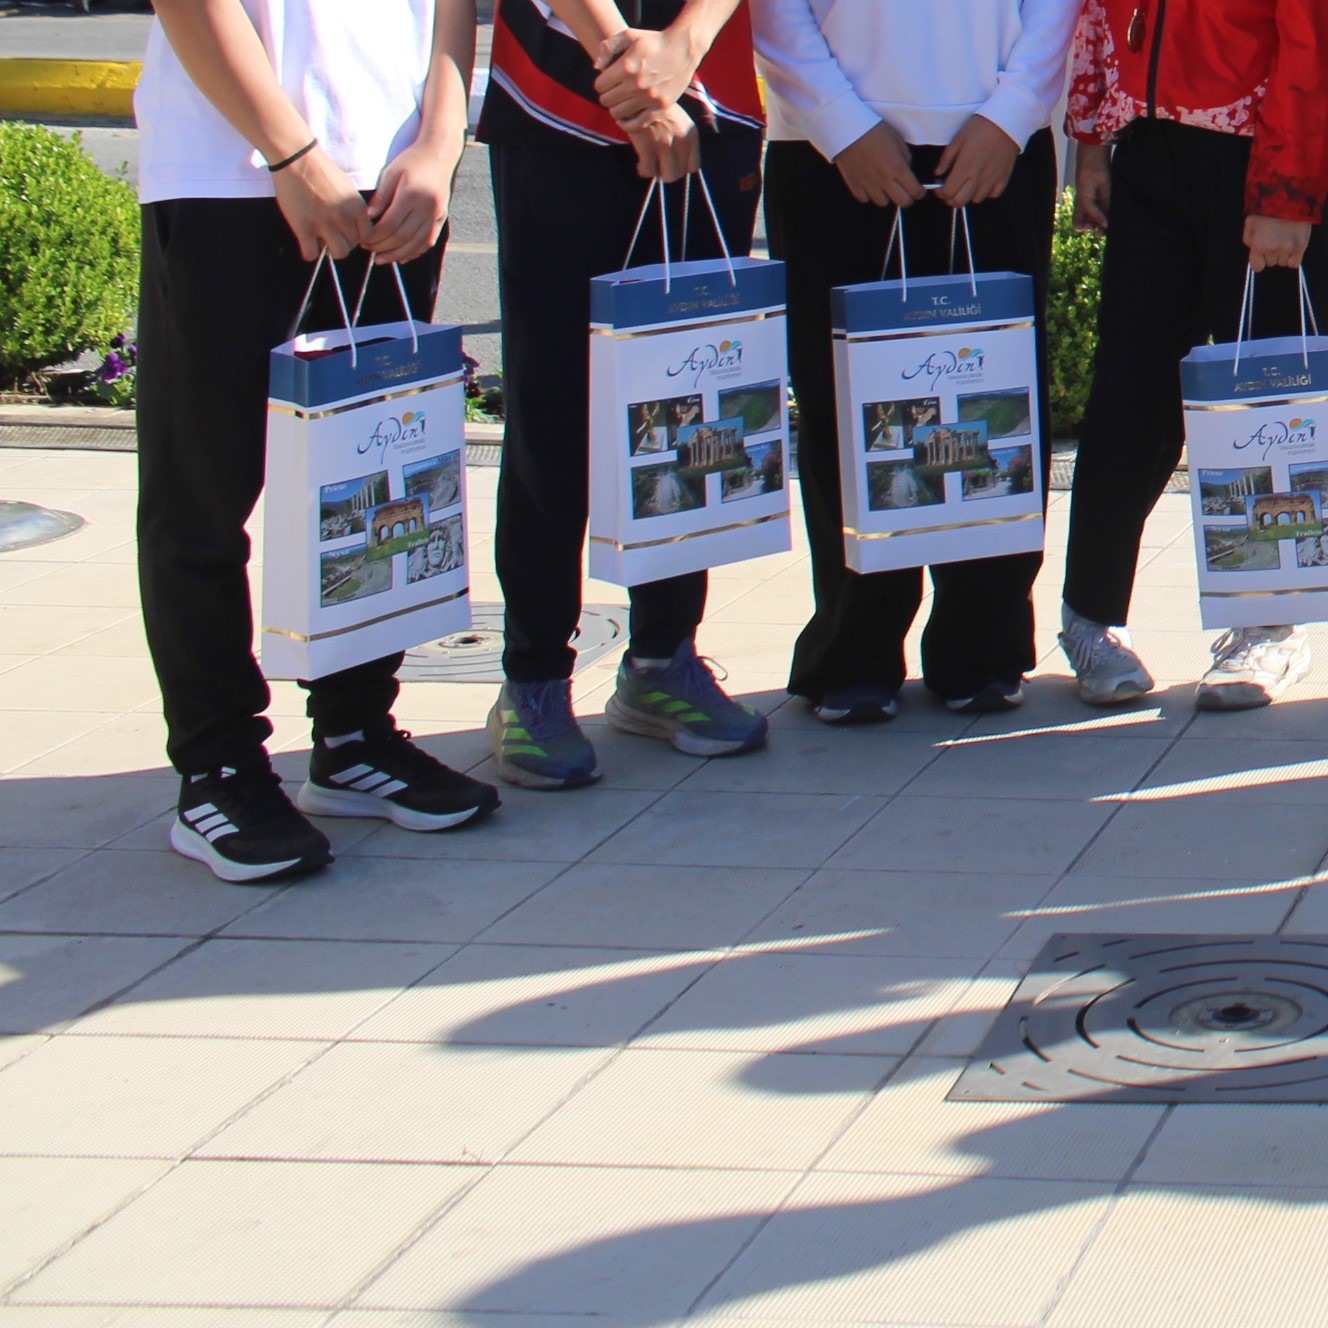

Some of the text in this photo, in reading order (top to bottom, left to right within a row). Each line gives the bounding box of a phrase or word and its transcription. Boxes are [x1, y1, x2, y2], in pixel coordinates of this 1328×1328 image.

[931, 296, 951, 306] T.C.
[939, 303, 982, 317] VALİLİĞİ
[1271, 374, 1312, 388] VALİLİĞİ
